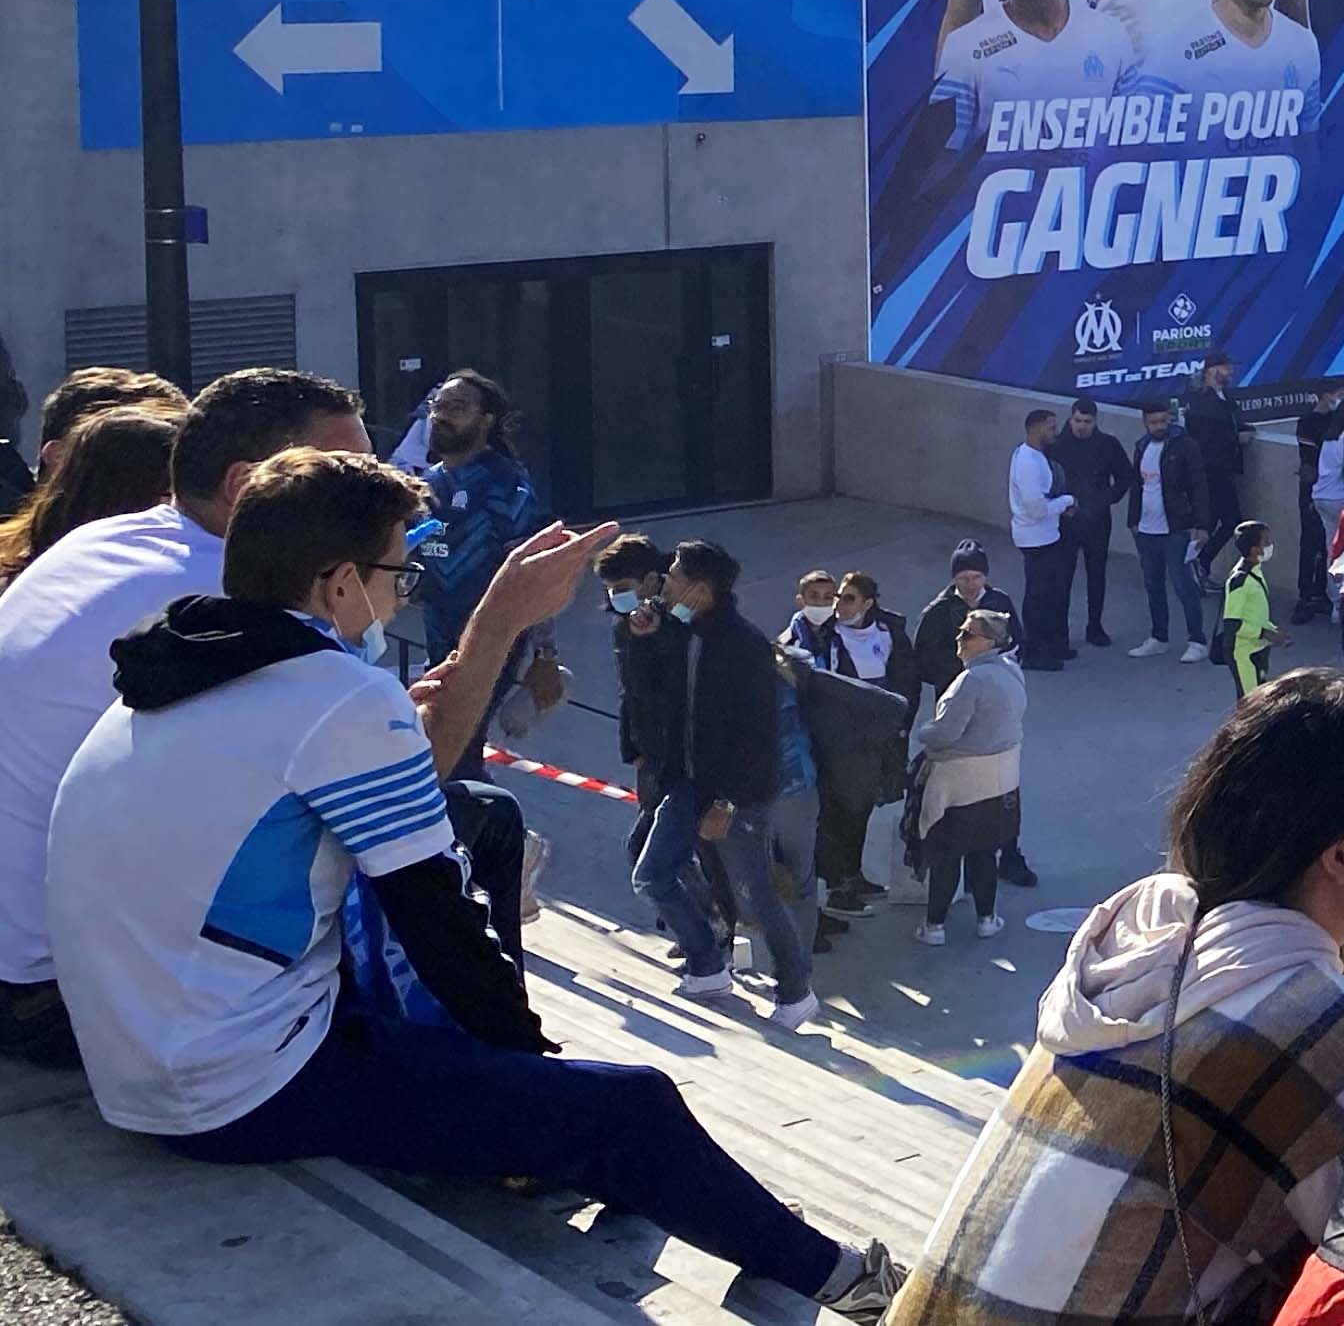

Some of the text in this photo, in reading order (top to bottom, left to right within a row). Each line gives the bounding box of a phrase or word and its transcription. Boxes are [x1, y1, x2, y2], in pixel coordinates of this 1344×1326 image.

[986, 90, 1304, 152] ENSEMBLE POUR
[966, 154, 1300, 280] GAGNER
[1152, 324, 1212, 342] PARIONS
